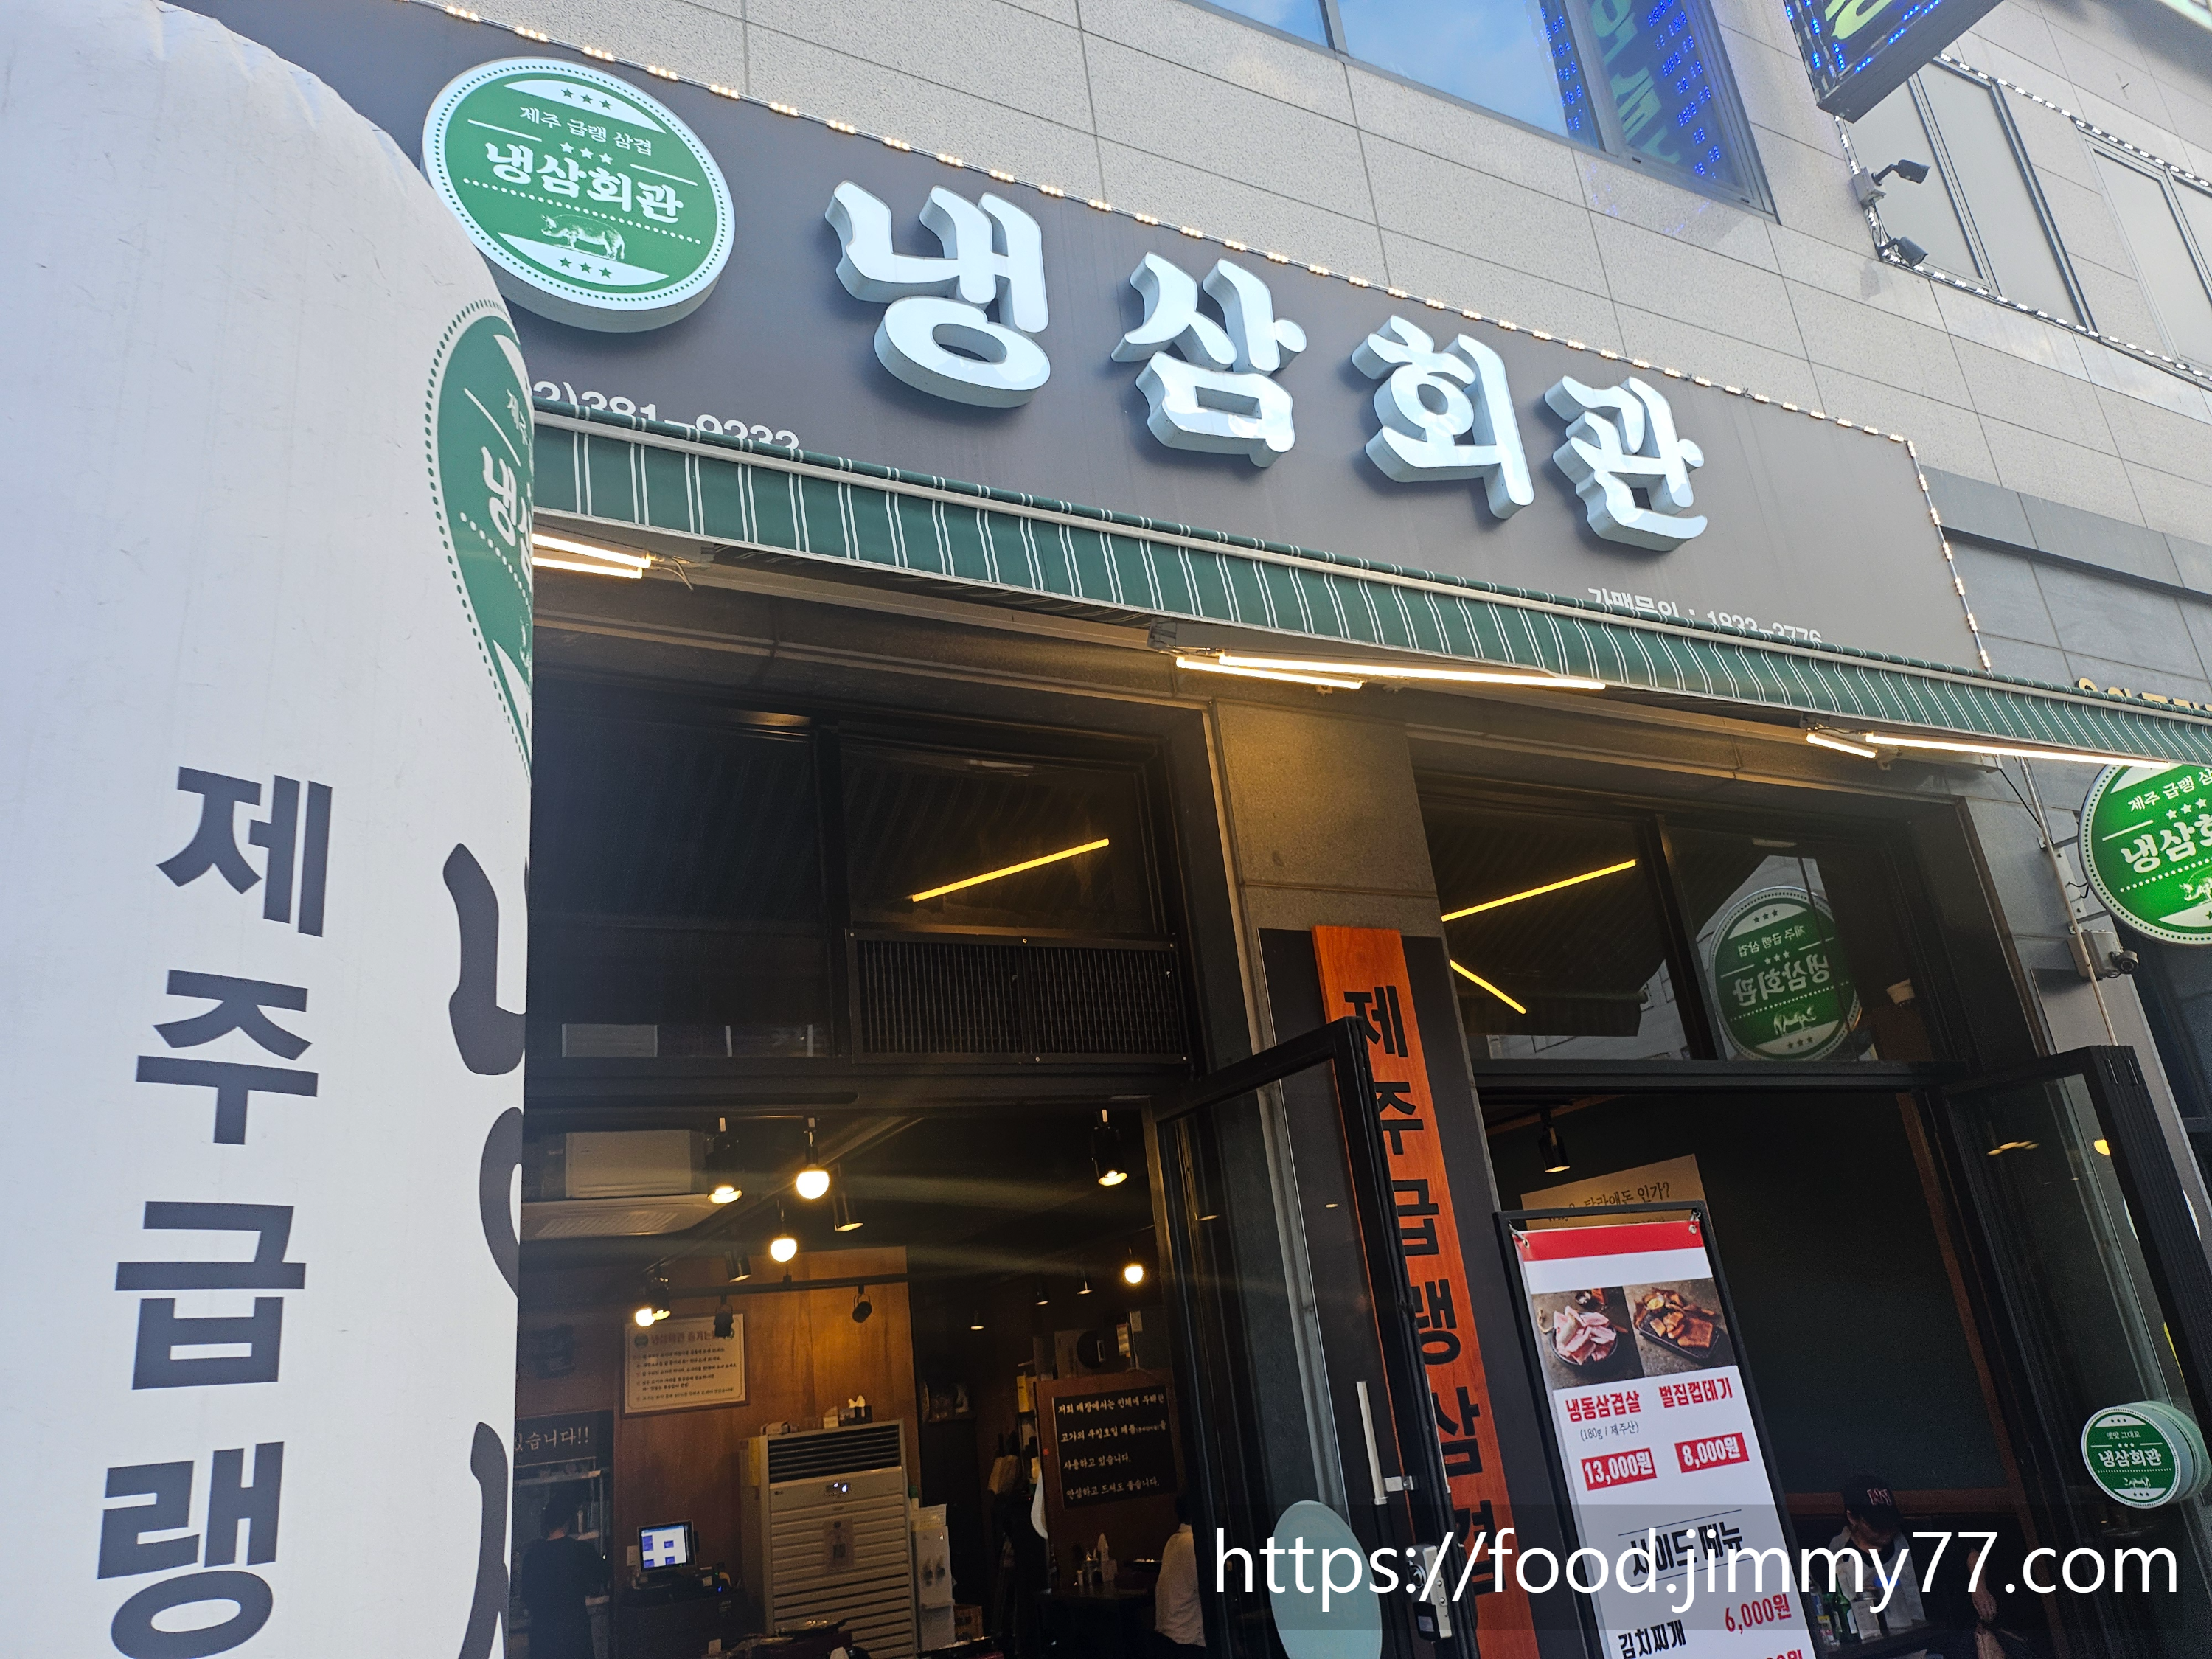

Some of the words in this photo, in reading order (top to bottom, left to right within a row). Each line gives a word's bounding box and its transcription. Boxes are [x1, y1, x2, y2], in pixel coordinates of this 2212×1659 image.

[520, 107, 561, 128] 제주
[567, 119, 607, 142] 급랭
[613, 132, 651, 156] 삼겹
[484, 142, 684, 223] 냉삼회관
[826, 181, 1708, 550] 냉삼회관
[2128, 791, 2160, 812] 제주
[2163, 776, 2195, 799] 급랭
[1637, 1181, 1670, 1203] 인가?
[1058, 1403, 1074, 1415] 저희
[1076, 1399, 1116, 1413] 매장에서는
[1565, 1390, 1641, 1422] 냉동삼겹살
[1659, 1377, 1733, 1408] 벌집껍데기
[1580, 1428, 1603, 1441] (180g
[1063, 1457, 1096, 1471] 사용하고
[1584, 1449, 1654, 1485] 13,000원
[1682, 1436, 1741, 1469] 8,000원
[2098, 1448, 2161, 1467] 냉삼회관
[1066, 1486, 1099, 1500] 안심하고
[1618, 1619, 1687, 1659] 김치찌개
[1725, 1593, 1792, 1634] 6,000원
